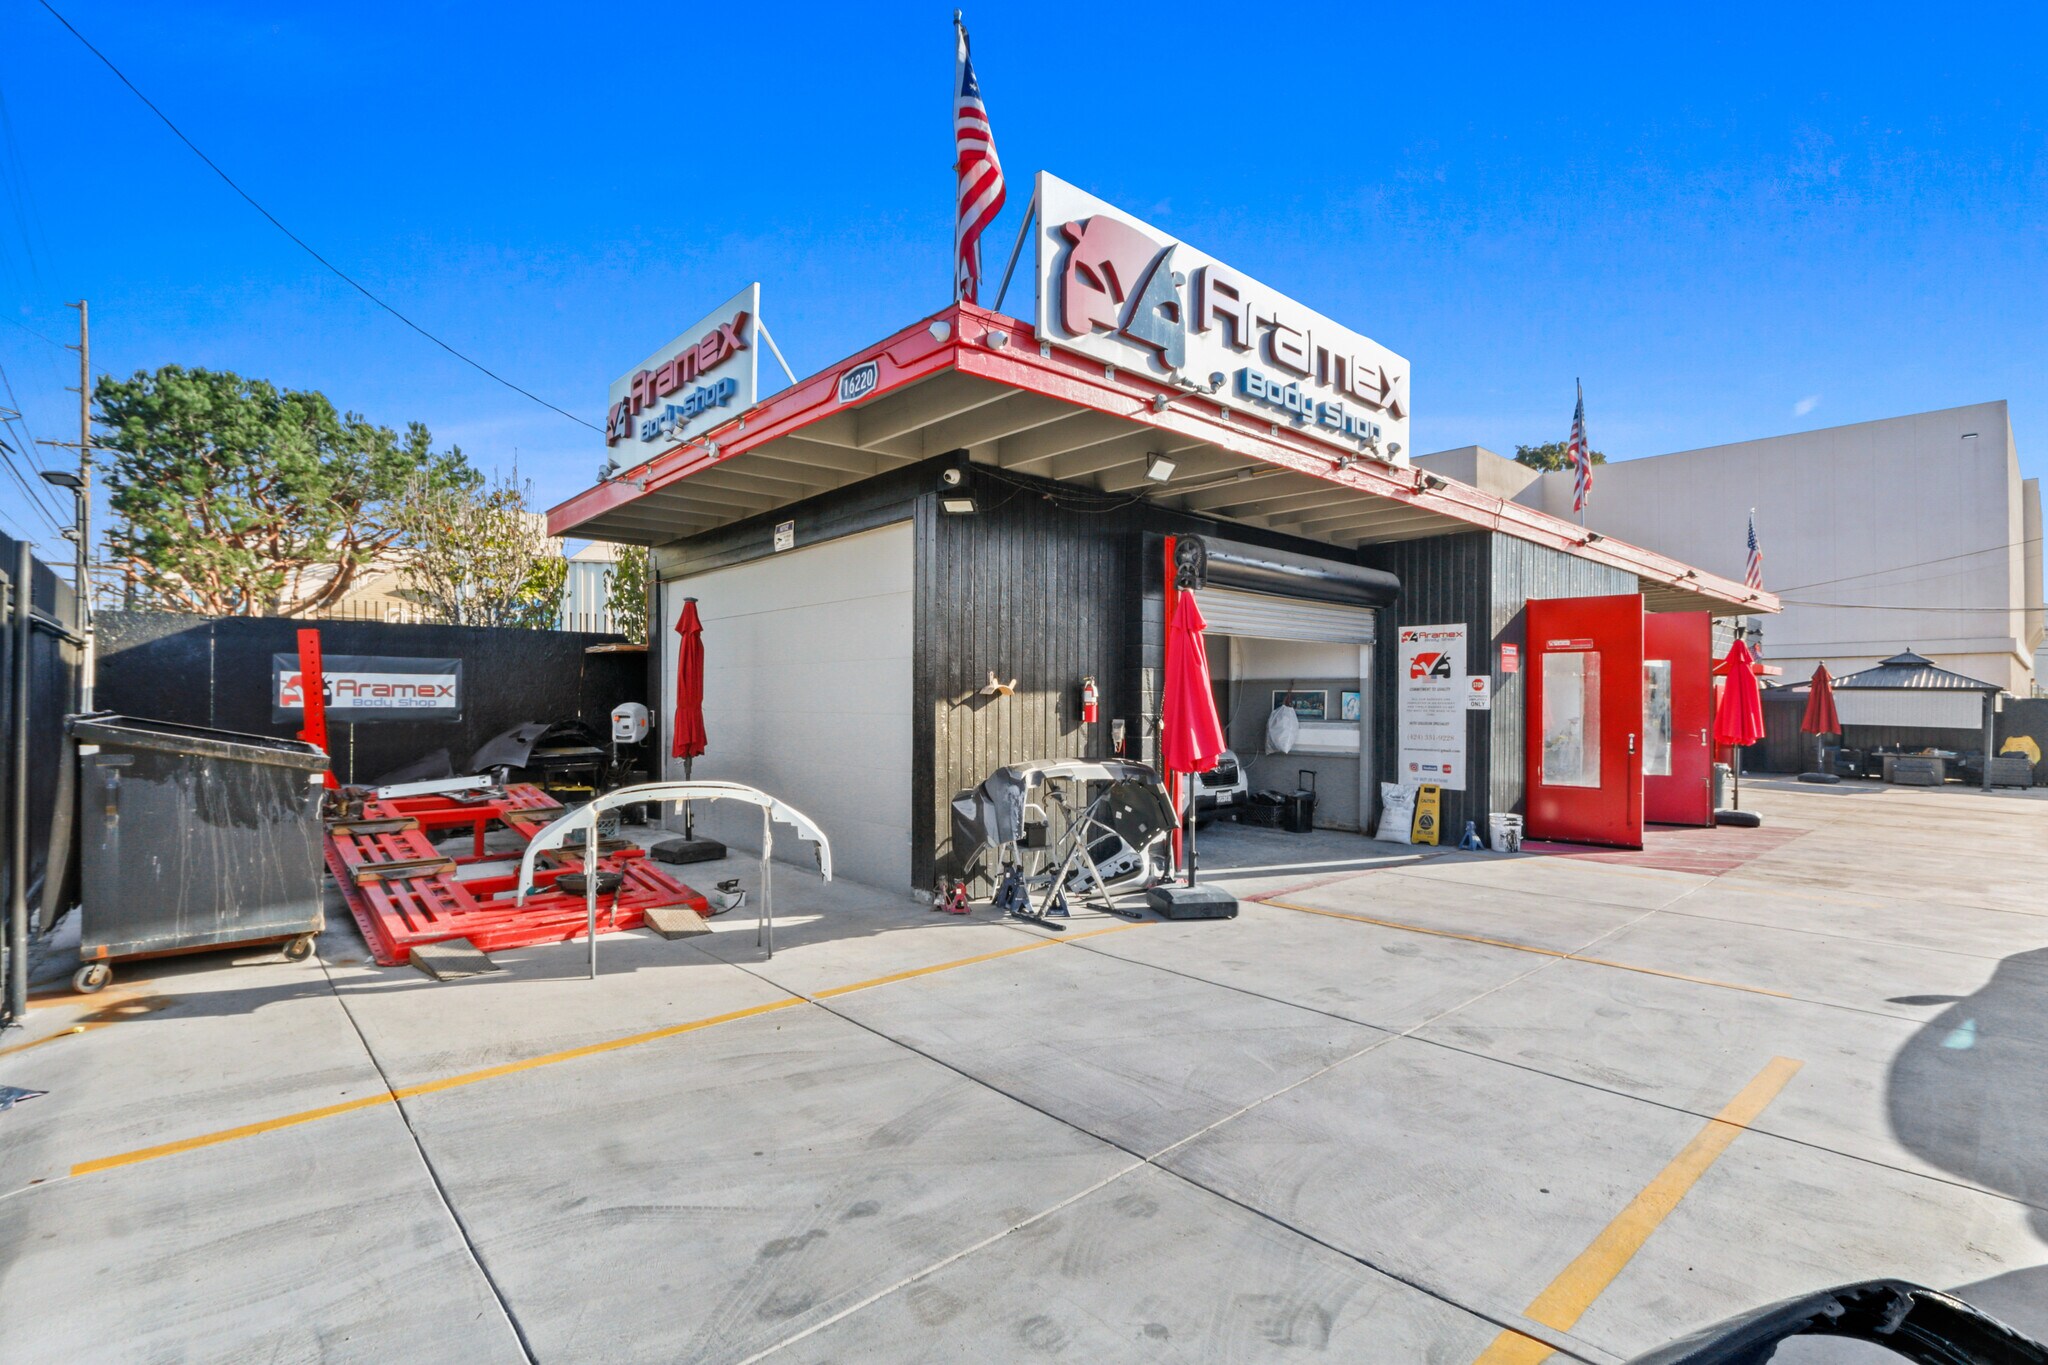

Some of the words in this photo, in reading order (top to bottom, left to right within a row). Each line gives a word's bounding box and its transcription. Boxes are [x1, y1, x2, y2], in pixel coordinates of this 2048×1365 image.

[1198, 264, 1408, 418] Aramex
[629, 310, 750, 416] Aramex
[842, 368, 875, 397] 16220
[683, 376, 736, 419] Shop
[1240, 366, 1316, 425] Body
[1317, 400, 1382, 443] Shop
[335, 679, 456, 698] Aramex
[352, 697, 393, 707] Body
[399, 698, 437, 708] Shop
